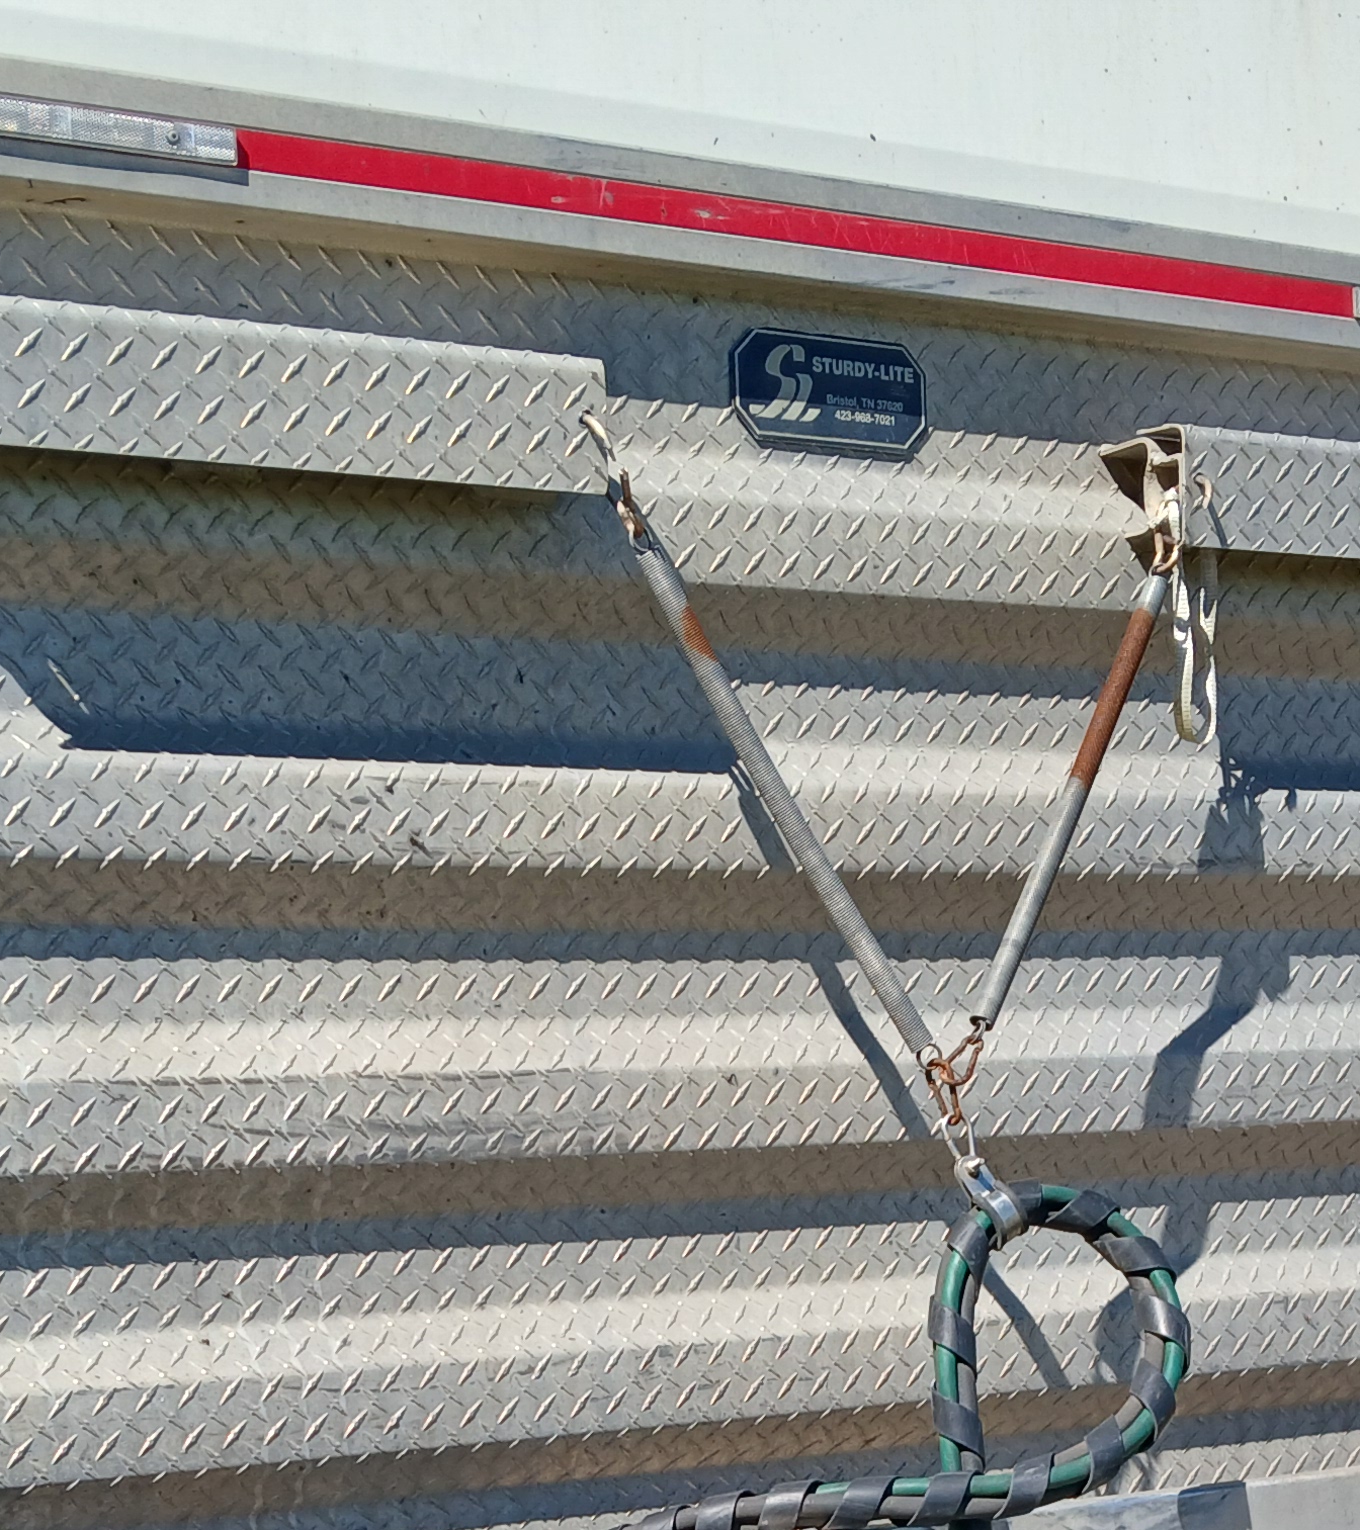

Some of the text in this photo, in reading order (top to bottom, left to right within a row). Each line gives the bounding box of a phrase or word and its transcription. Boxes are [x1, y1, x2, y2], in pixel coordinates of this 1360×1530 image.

[811, 356, 915, 384] STURDY-LITE
[826, 394, 859, 410] Bristol,
[861, 397, 875, 410] TN
